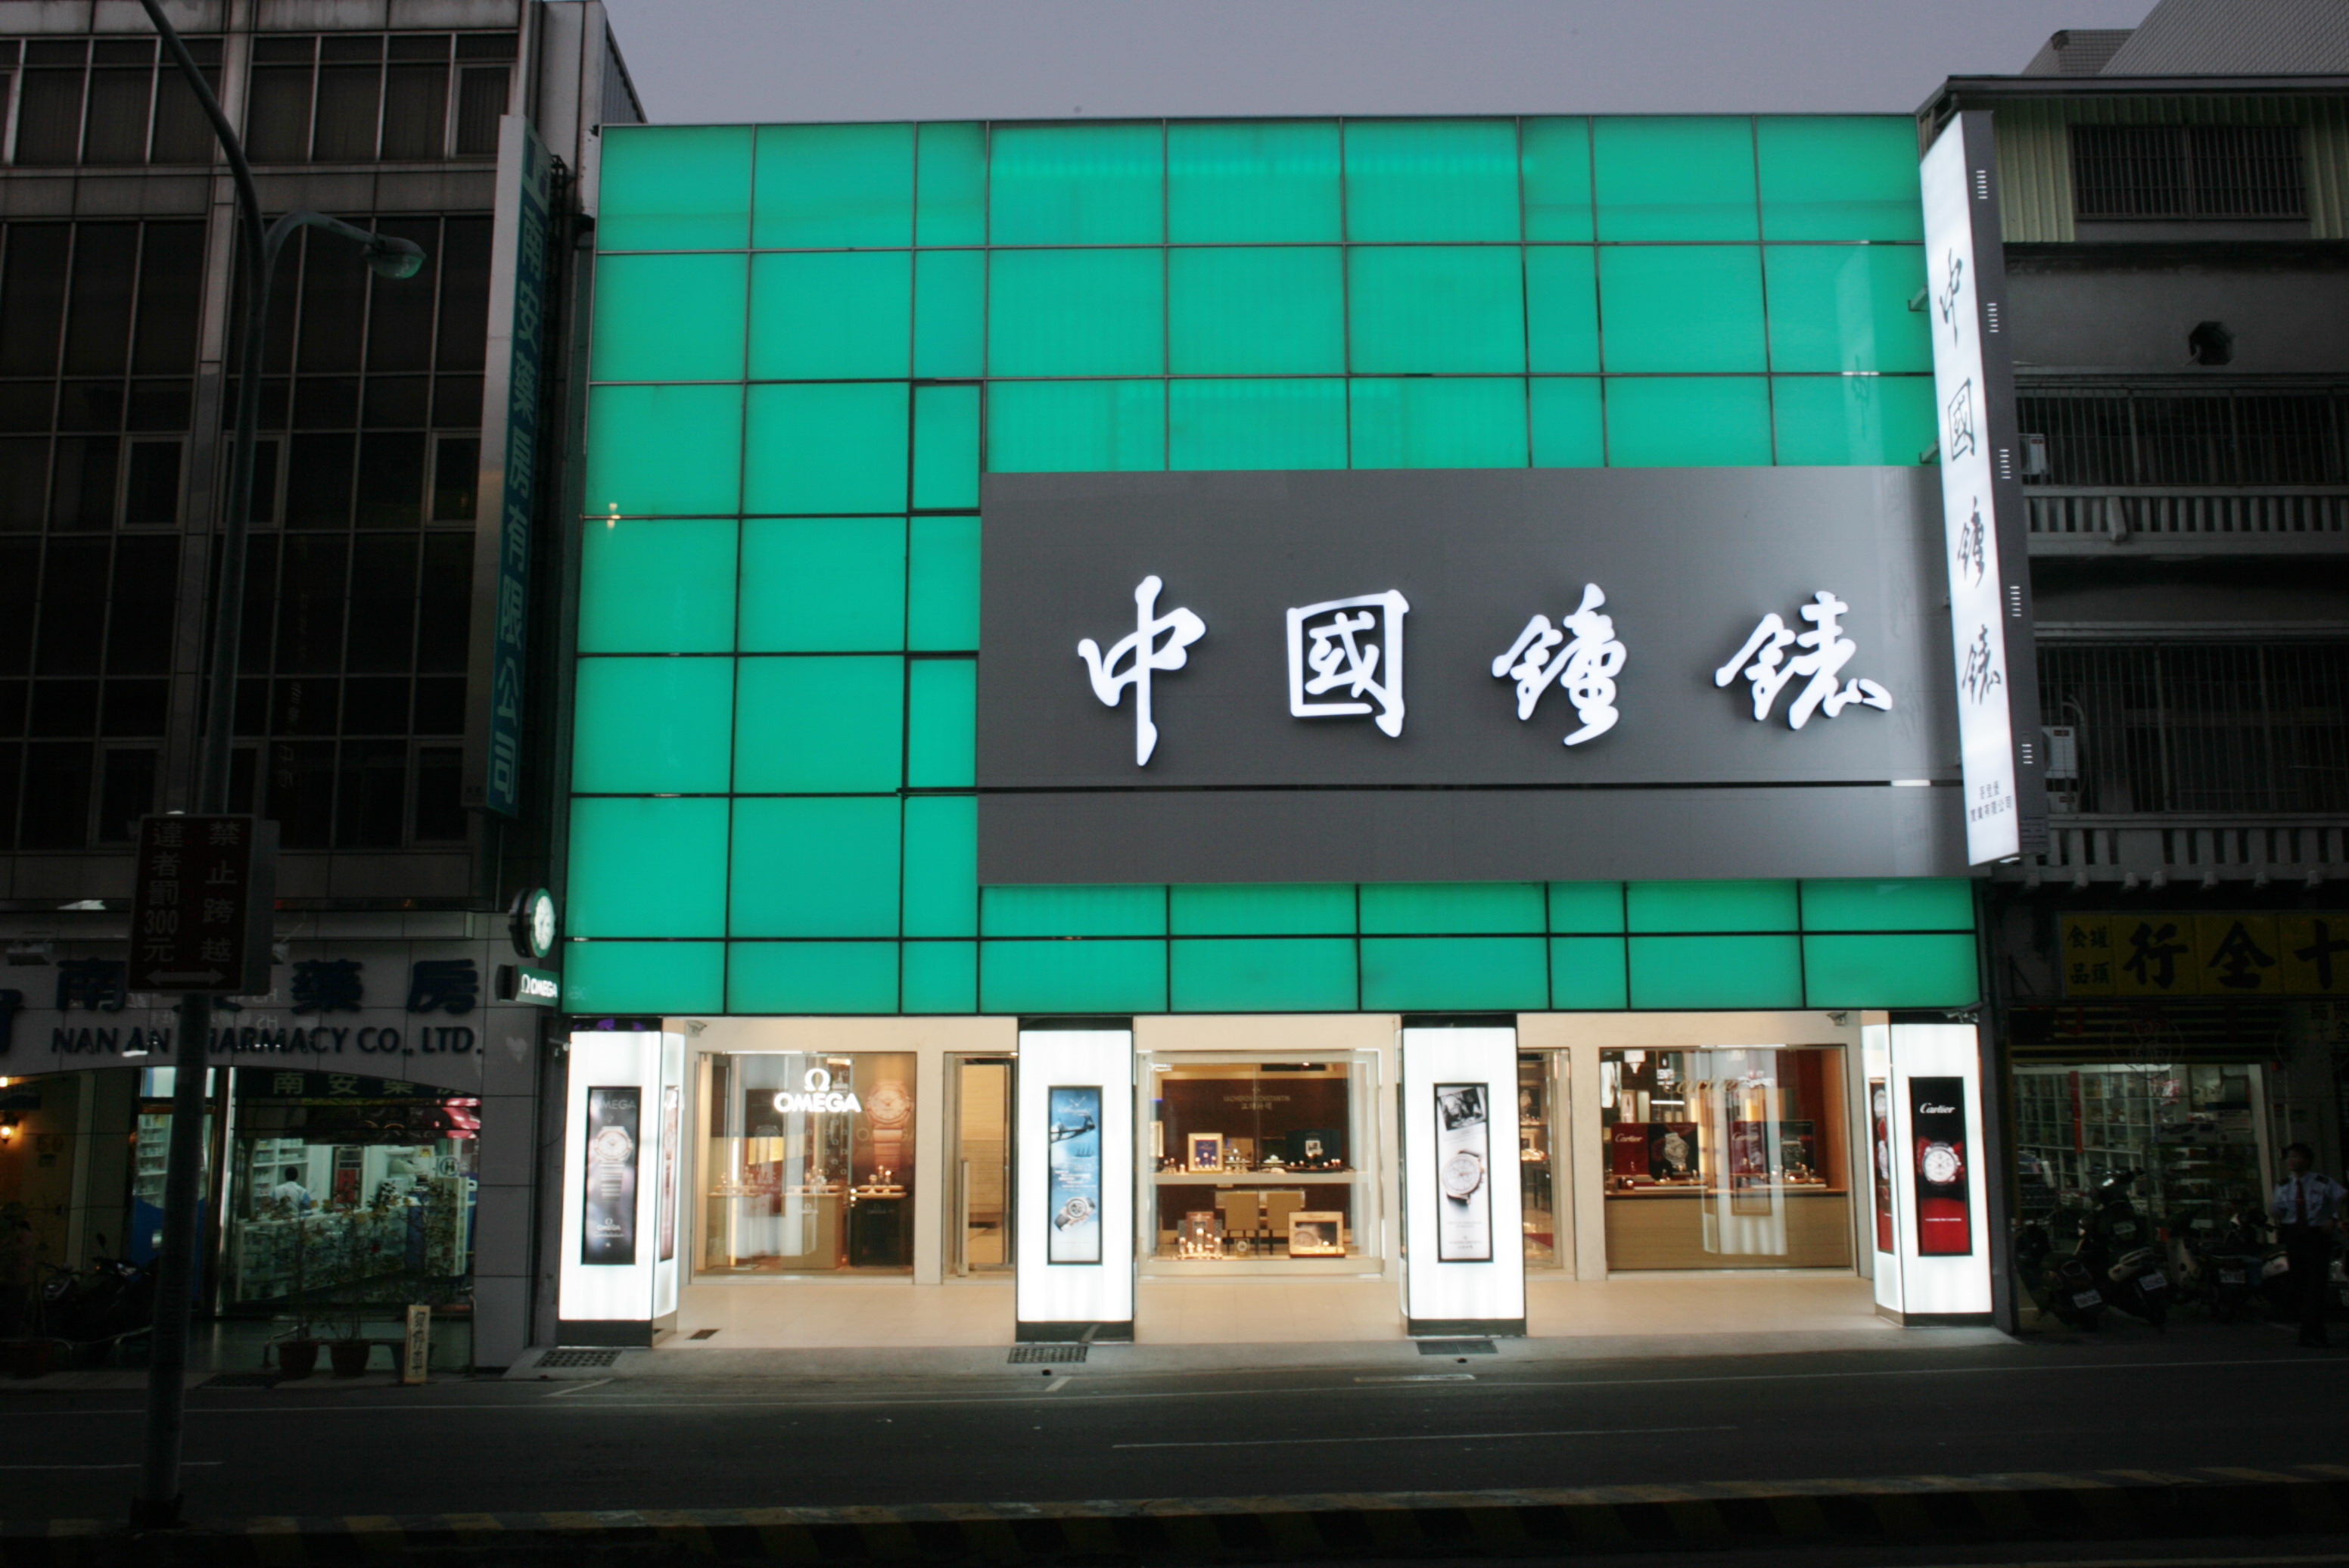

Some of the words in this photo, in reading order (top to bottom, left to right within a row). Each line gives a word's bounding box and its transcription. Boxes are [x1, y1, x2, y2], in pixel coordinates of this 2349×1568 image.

[200, 821, 241, 963] 禁止跨越
[56, 957, 479, 1014] 南藥房
[530, 977, 558, 998] OMEGA
[51, 1027, 118, 1053] NAN
[125, 1026, 170, 1053] AN
[207, 1026, 350, 1054] ARMACY
[422, 1026, 483, 1055] LTD.
[595, 1099, 638, 1110] MEGA
[773, 1091, 862, 1113] OMEGA
[1920, 1102, 1957, 1115] Cartier
[1615, 1132, 1644, 1143] Cartier
